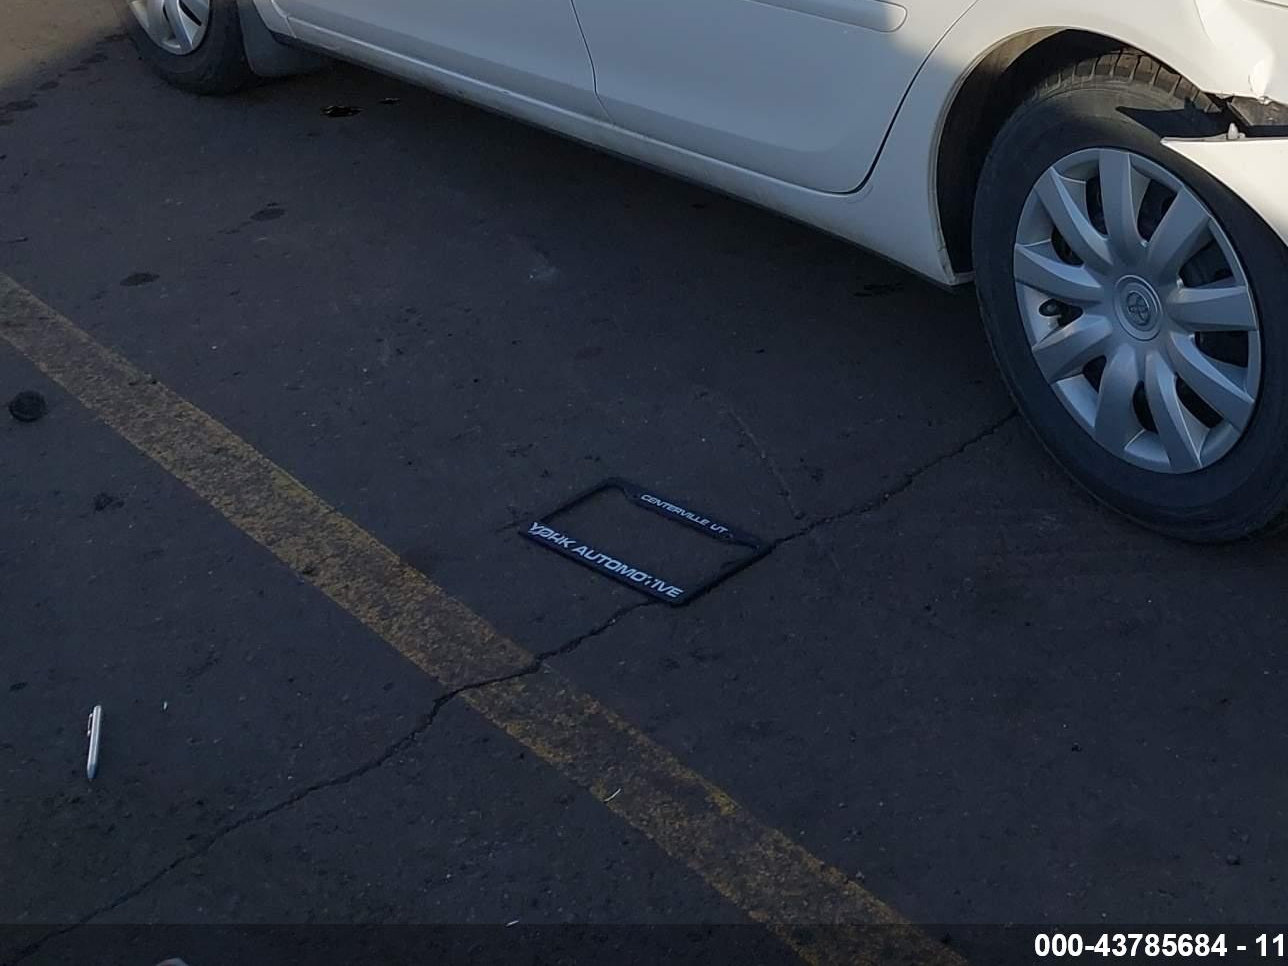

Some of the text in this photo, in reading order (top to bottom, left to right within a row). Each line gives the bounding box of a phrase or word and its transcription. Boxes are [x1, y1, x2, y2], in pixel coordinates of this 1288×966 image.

[640, 493, 729, 534] CENTERVILLE UT
[571, 545, 684, 598] AUTOMOTIVE
